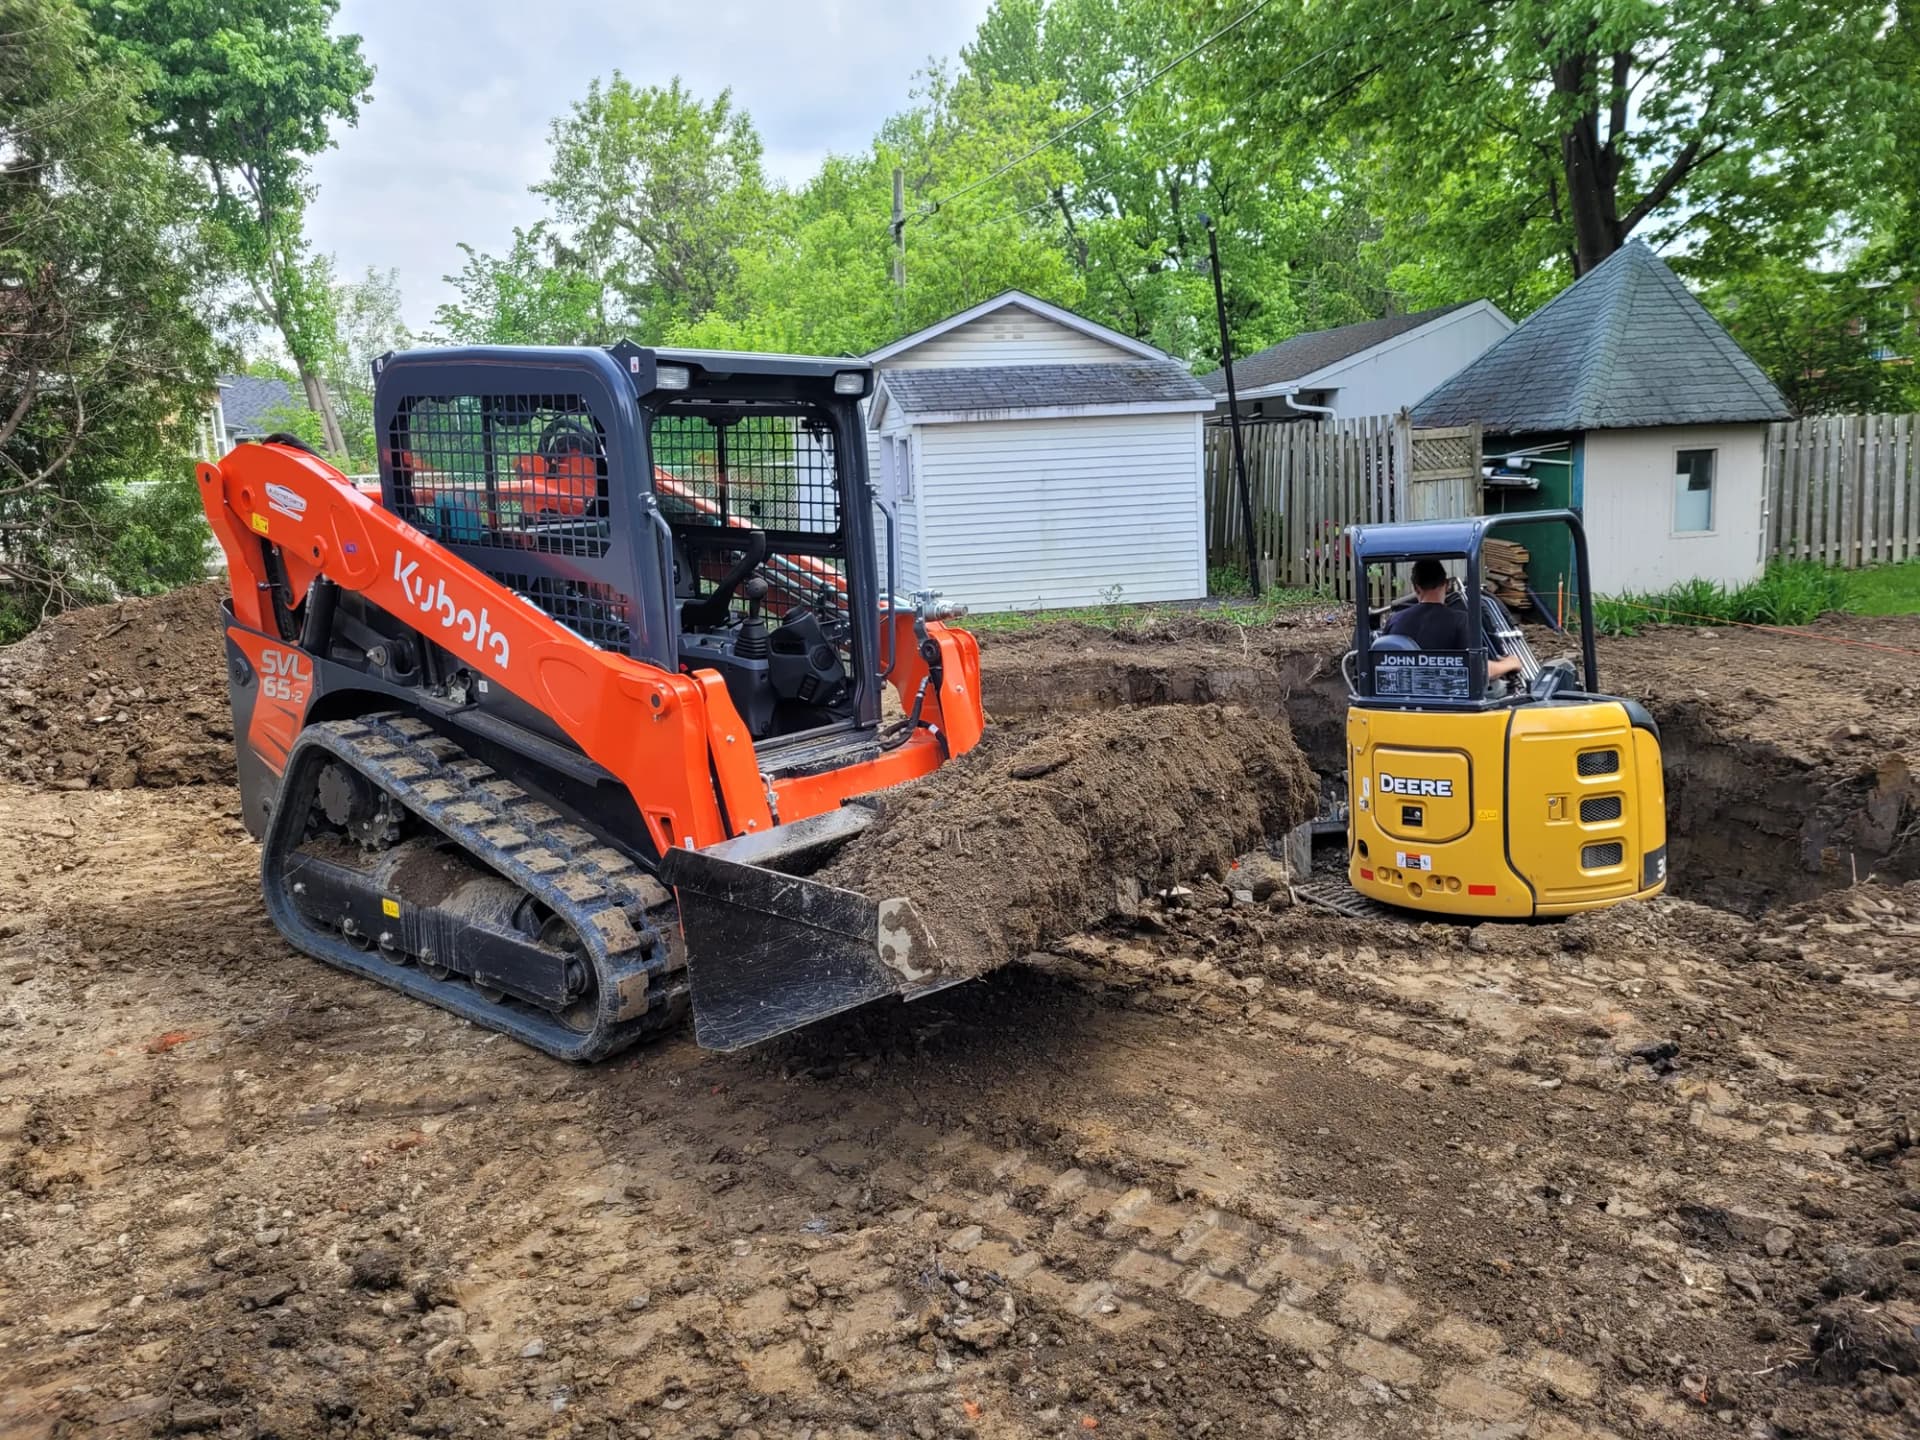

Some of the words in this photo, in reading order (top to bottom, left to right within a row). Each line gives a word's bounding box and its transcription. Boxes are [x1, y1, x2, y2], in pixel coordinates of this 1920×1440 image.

[394, 550, 510, 669] Kubota
[261, 649, 308, 681] SVL
[1381, 654, 1415, 666] JOHN
[1418, 655, 1464, 666] DEERE
[263, 676, 304, 703] 65-2
[1380, 773, 1453, 797] DEERE
